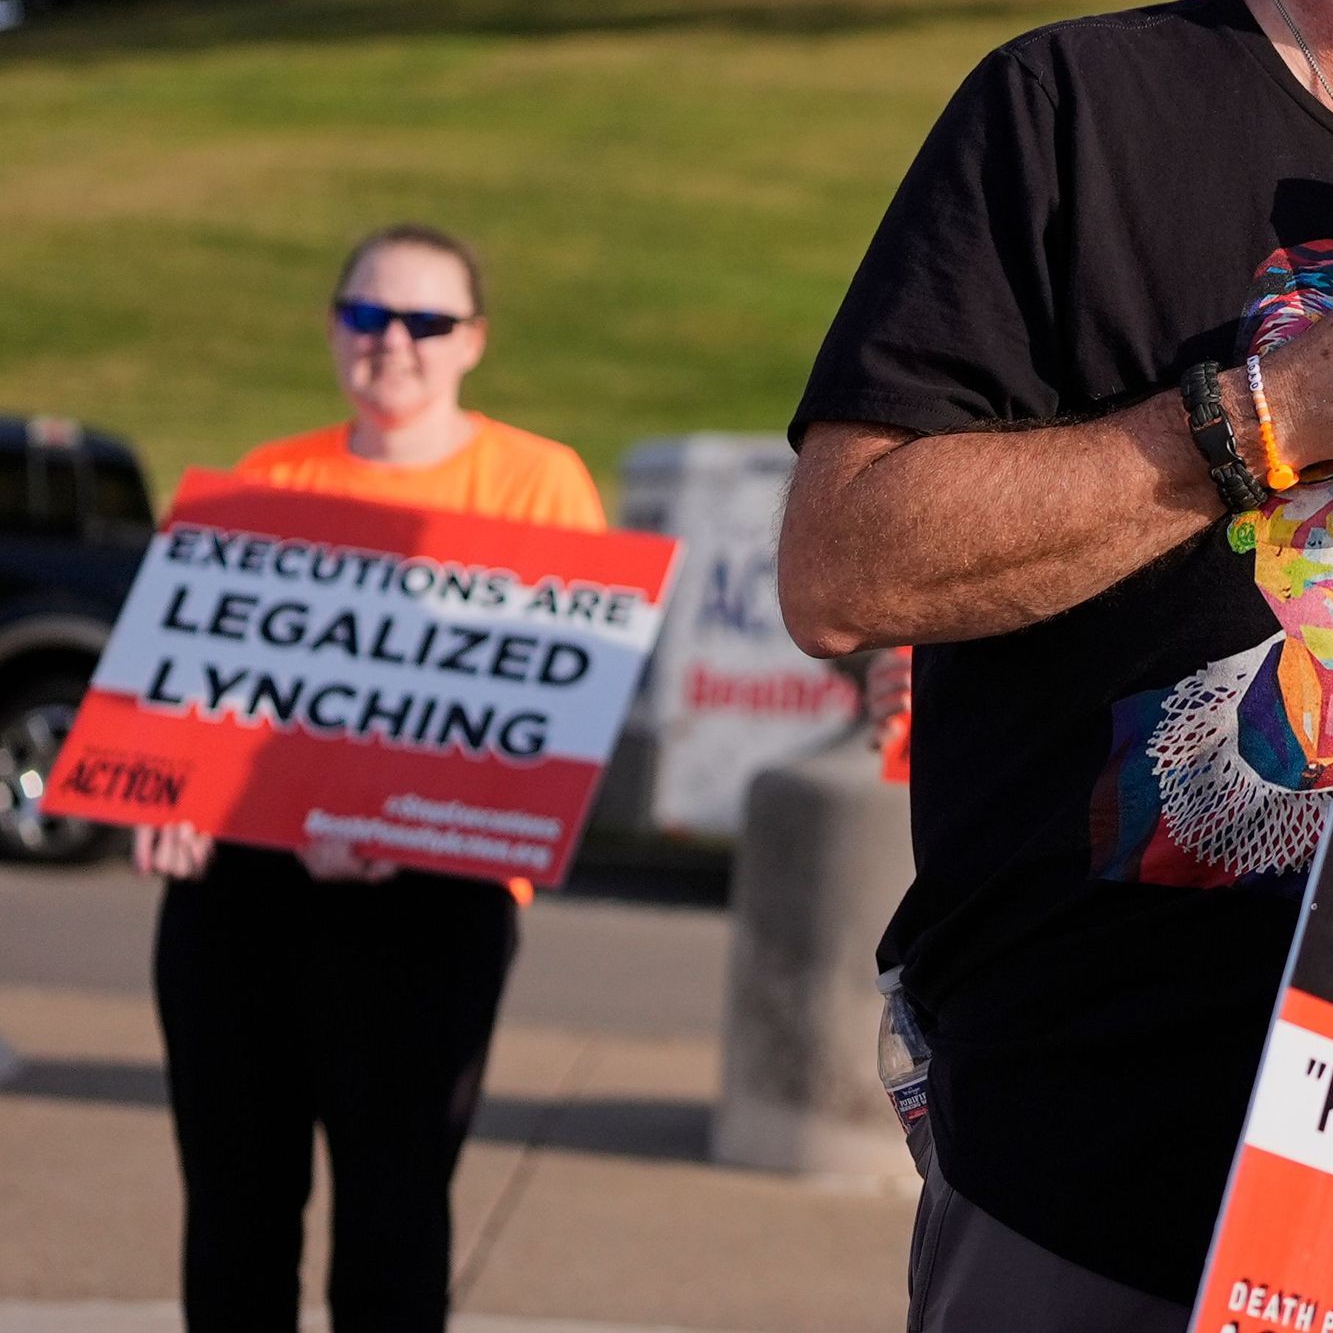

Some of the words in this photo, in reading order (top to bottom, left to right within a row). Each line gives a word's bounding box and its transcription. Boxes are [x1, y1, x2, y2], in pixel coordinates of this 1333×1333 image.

[164, 527, 511, 608] EXECUTIONS
[529, 582, 641, 626] ARE
[161, 586, 591, 688] LEGALIZED
[145, 658, 548, 759] LYNCHING
[1227, 1279, 1318, 1333] DEATH
